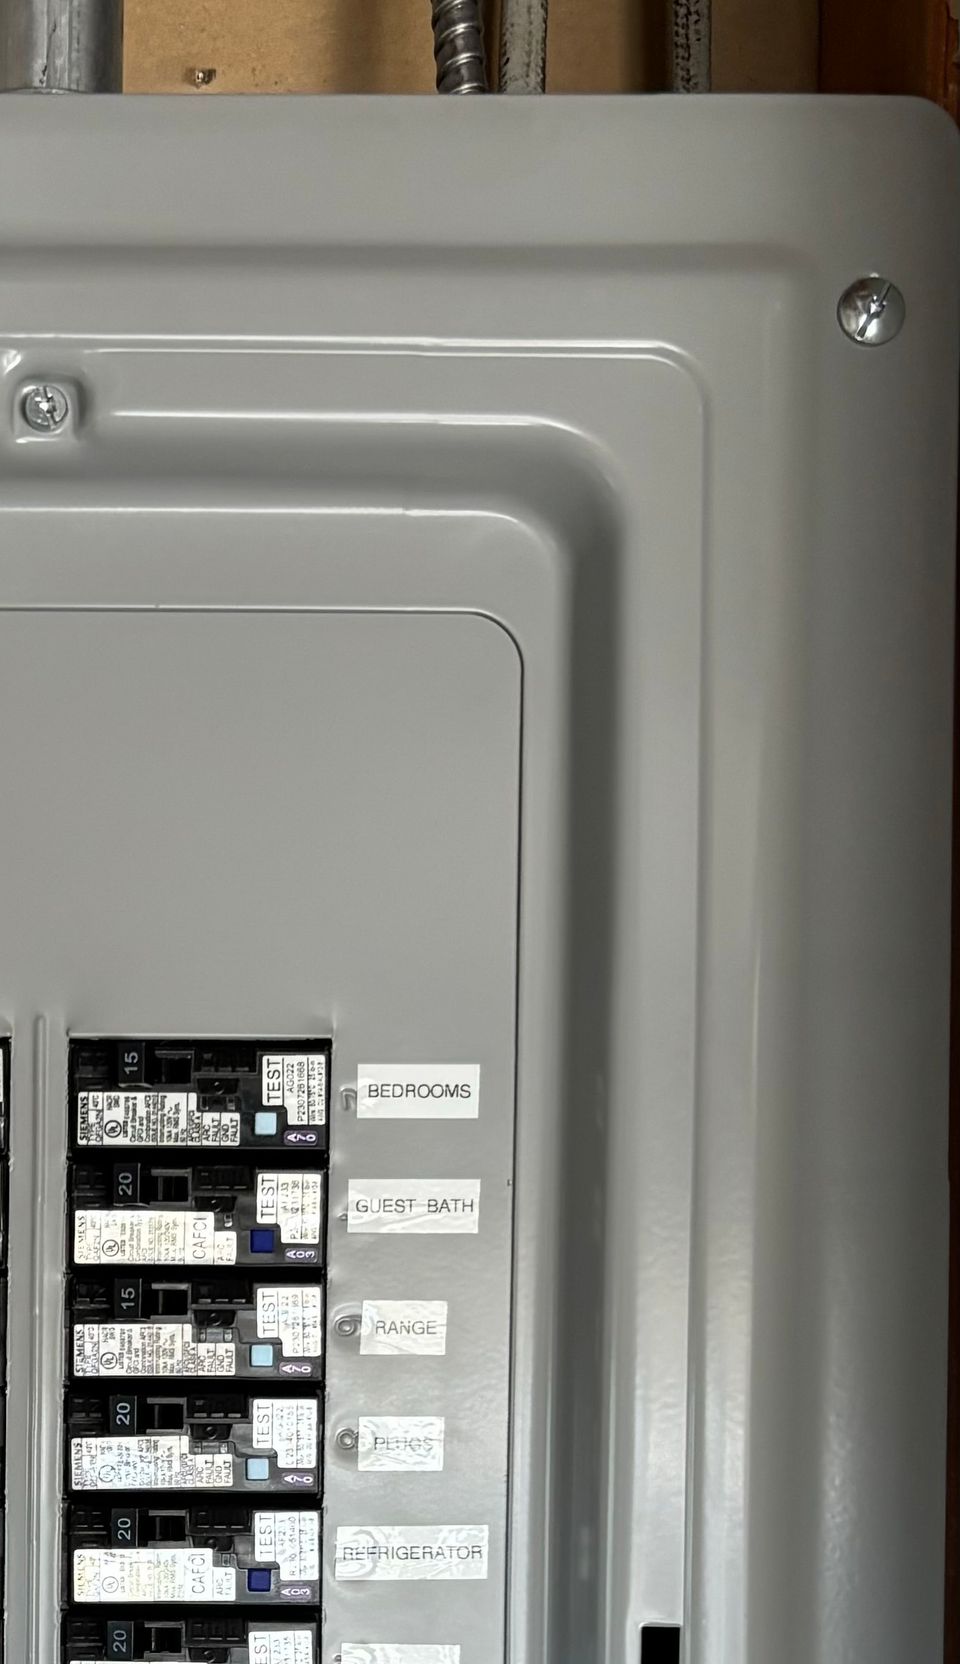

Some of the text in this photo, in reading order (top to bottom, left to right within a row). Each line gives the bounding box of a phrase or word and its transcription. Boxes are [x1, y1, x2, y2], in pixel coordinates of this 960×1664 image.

[125, 1052, 138, 1074] 15
[267, 1058, 280, 1103] TEST
[367, 1084, 471, 1098] BEDROOMS
[80, 1096, 88, 1141] SIEMENS
[118, 1172, 132, 1196] 20
[261, 1175, 274, 1219] TEST
[355, 1198, 474, 1214] GUEST BATH
[192, 1217, 207, 1259] CAFCI
[121, 1288, 135, 1309] 15
[262, 1291, 275, 1335] TEST
[375, 1320, 437, 1335] RANGE
[76, 1329, 84, 1373] SIEMENS
[116, 1402, 130, 1425] 20
[257, 1403, 270, 1446] TEST
[74, 1443, 82, 1486] SIEMENS
[118, 1517, 131, 1540] 20
[260, 1515, 272, 1558] TEST
[343, 1545, 483, 1561] REFRIGERATOR
[190, 1553, 205, 1594] CAFCI
[113, 1630, 127, 1652] 20
